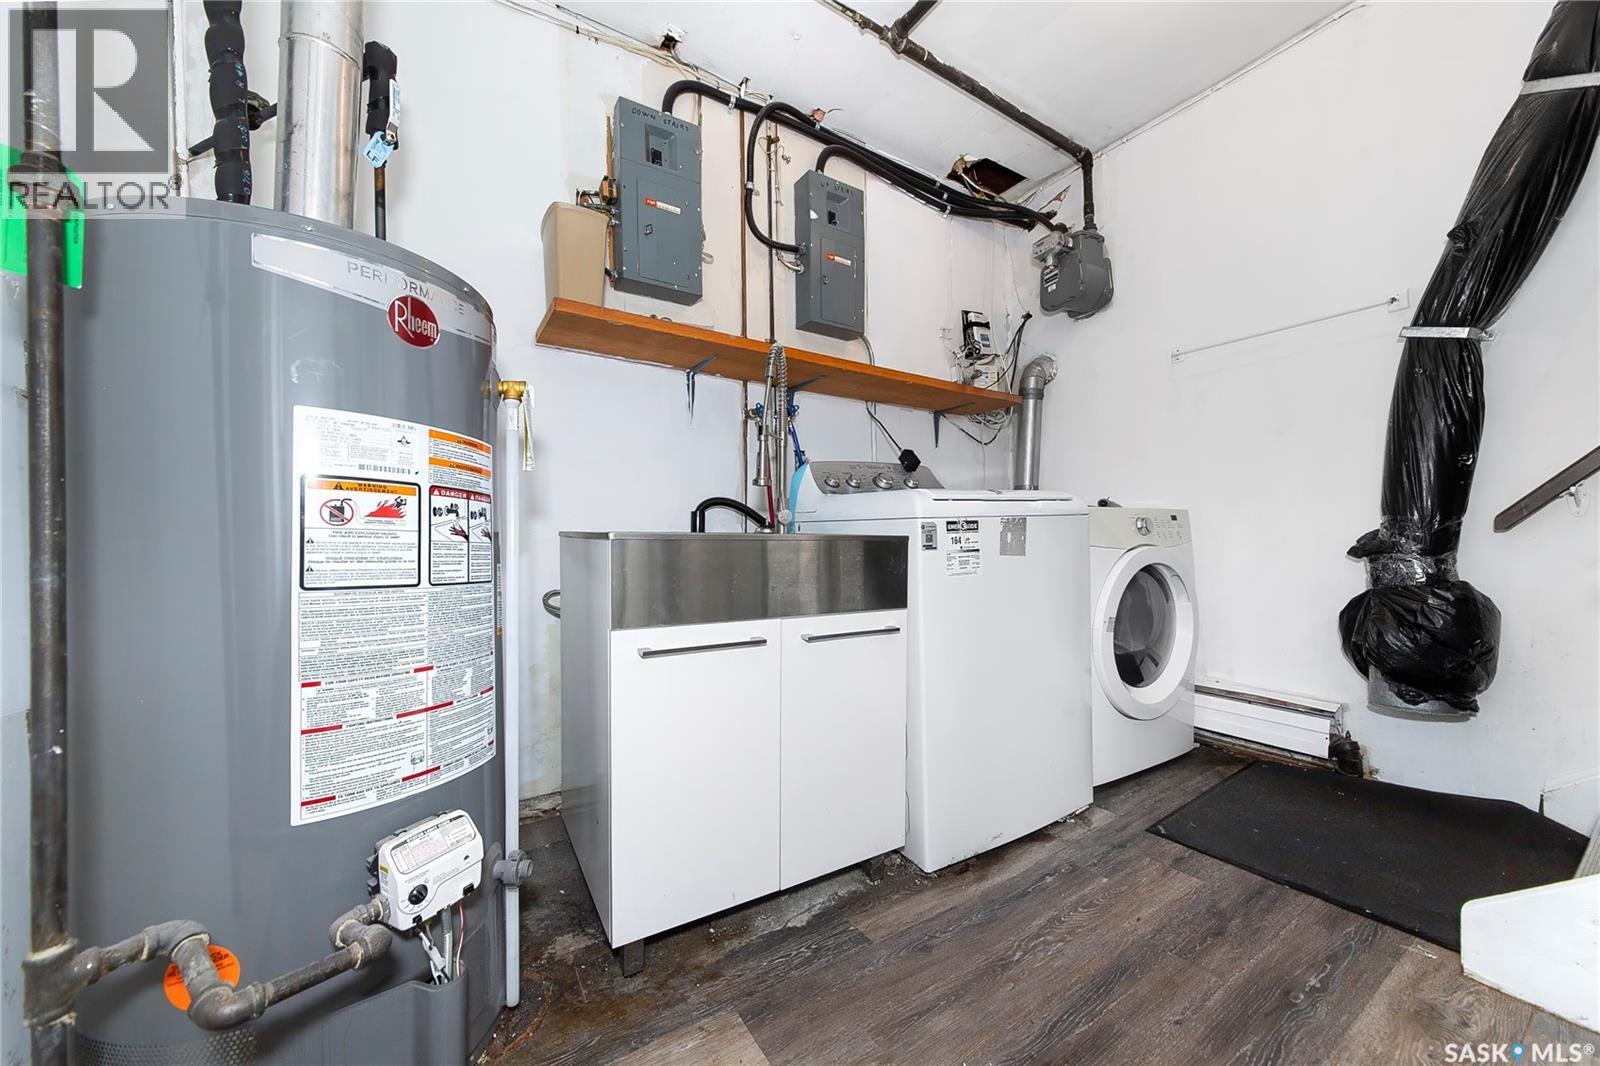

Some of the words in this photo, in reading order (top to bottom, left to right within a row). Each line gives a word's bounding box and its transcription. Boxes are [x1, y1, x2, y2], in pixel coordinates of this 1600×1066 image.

[631, 107, 656, 120] DOWN
[663, 119, 688, 131] STAIRS
[366, 150, 379, 162] LF
[346, 261, 465, 315] PERORME
[394, 297, 437, 339] Rheem
[440, 490, 467, 499] DANGER
